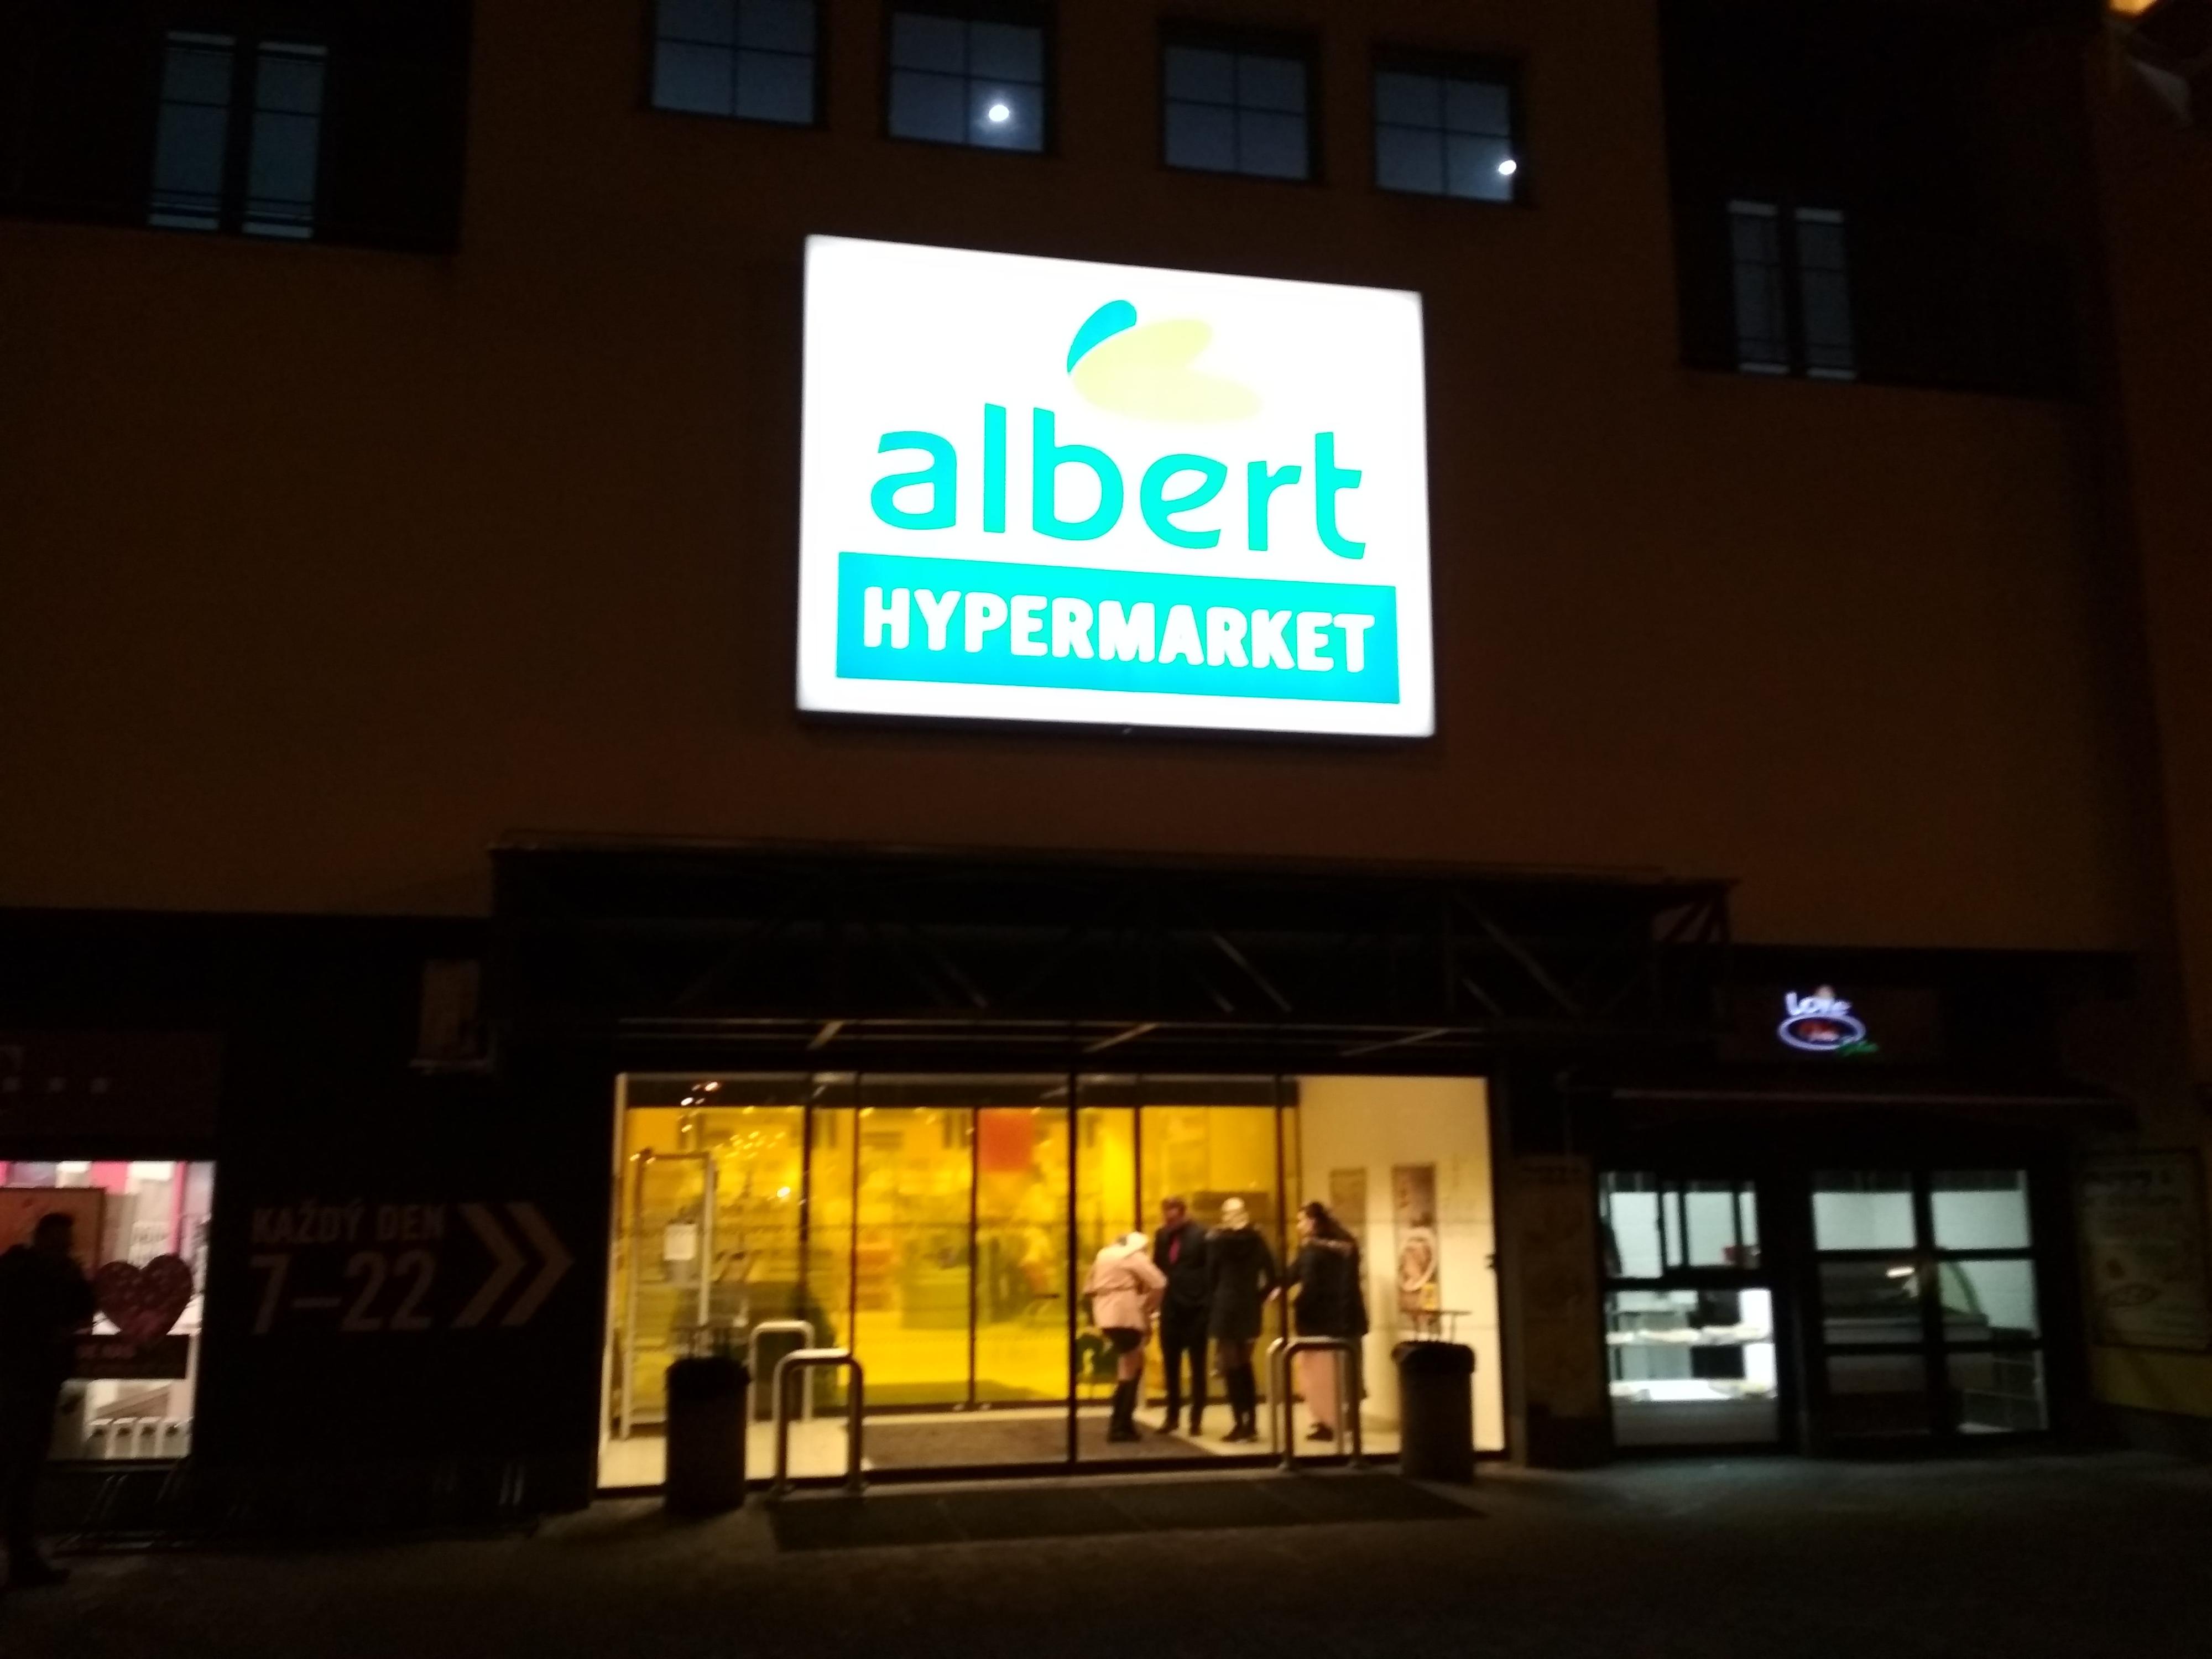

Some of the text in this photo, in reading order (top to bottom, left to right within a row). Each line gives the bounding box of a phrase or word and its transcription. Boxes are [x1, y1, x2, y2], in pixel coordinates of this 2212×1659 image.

[870, 403, 1366, 559] albert
[863, 586, 1375, 674] HYPERMARKET
[252, 1197, 445, 1243] KAŽDÝ DEN
